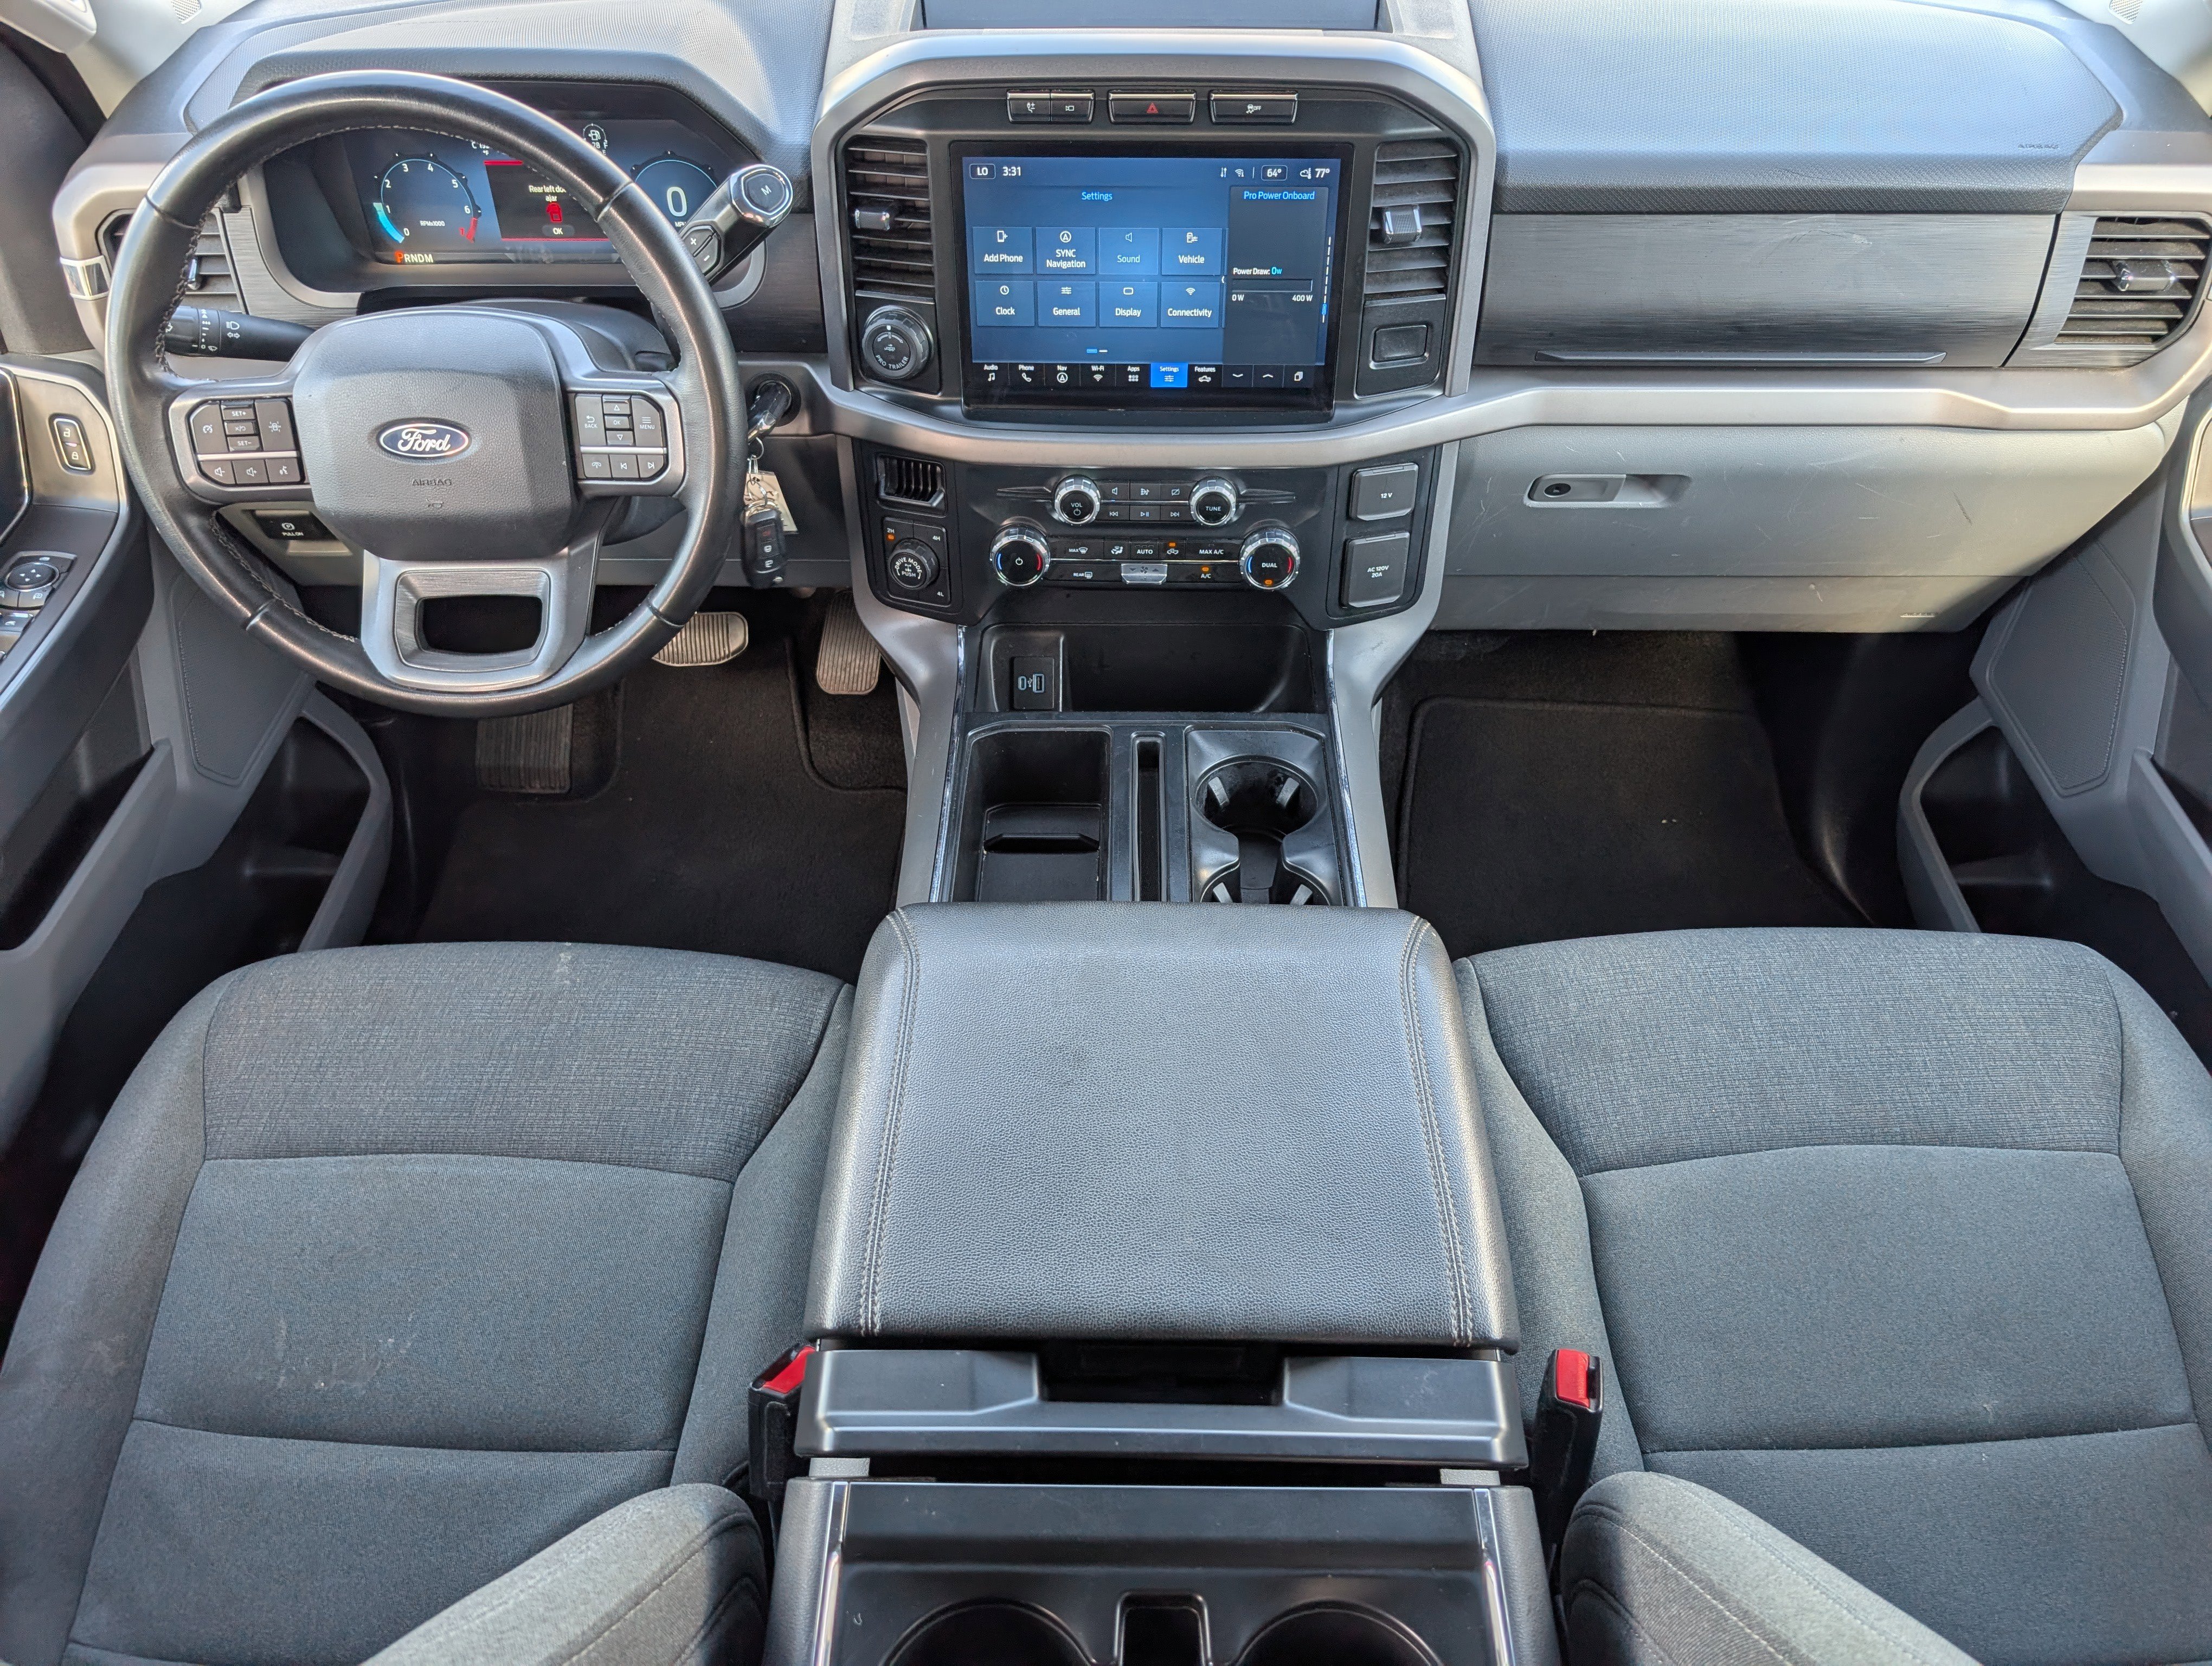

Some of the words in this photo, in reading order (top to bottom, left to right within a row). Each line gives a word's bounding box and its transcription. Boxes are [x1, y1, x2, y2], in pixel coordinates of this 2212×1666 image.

[403, 164, 409, 172] 3
[427, 164, 434, 172] 4
[977, 167, 988, 176] LO
[1003, 166, 1021, 176] 3:31
[1267, 168, 1282, 177] 64°
[1315, 168, 1330, 178] 77°
[385, 180, 391, 188] 2
[452, 180, 459, 188] 5
[529, 185, 543, 193] Rear
[543, 185, 555, 193] left
[761, 185, 772, 196] M
[545, 194, 557, 202] ajar
[1082, 191, 1113, 201] Settings
[1244, 191, 1257, 200] Pro
[1258, 191, 1281, 200] Power
[1282, 191, 1315, 200] Onboard
[667, 187, 687, 217] 0
[385, 205, 391, 214] 1
[464, 206, 471, 214] 6
[403, 228, 410, 236] 0
[1056, 249, 1076, 258] SYNC
[984, 254, 999, 262] Add
[1000, 254, 1023, 263] Phone
[1117, 255, 1140, 263] Sound
[1178, 255, 1205, 264] Vehicle
[1046, 259, 1086, 269] Navigation
[995, 306, 1015, 315] Clock
[1053, 307, 1081, 316] General
[1115, 307, 1141, 317] Display
[1168, 308, 1212, 318] Connectivity
[876, 355, 886, 366] PRO
[888, 356, 908, 369] TRAILER
[397, 428, 451, 451] Ford
[895, 557, 907, 571] DRIVE
[908, 558, 922, 573] MODE
